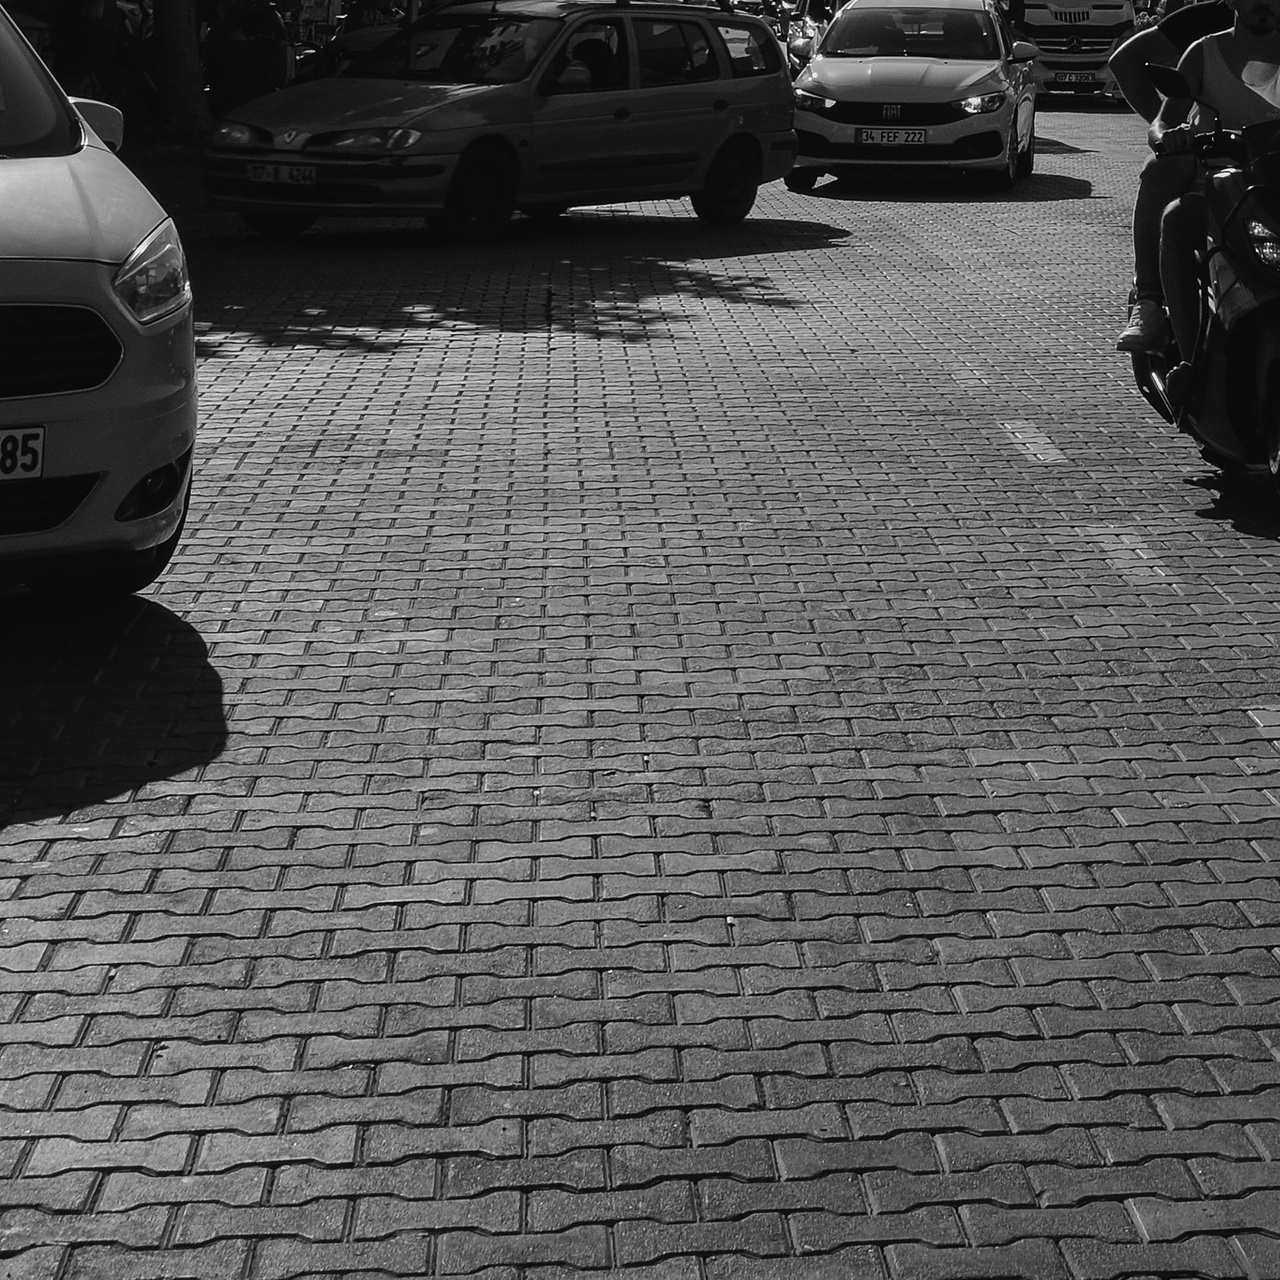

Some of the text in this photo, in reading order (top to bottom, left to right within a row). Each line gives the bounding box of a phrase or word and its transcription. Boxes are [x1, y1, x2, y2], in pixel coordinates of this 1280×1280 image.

[882, 104, 901, 118] FIAT
[863, 130, 923, 143] 34 FEF 222
[0, 433, 40, 474] 85
